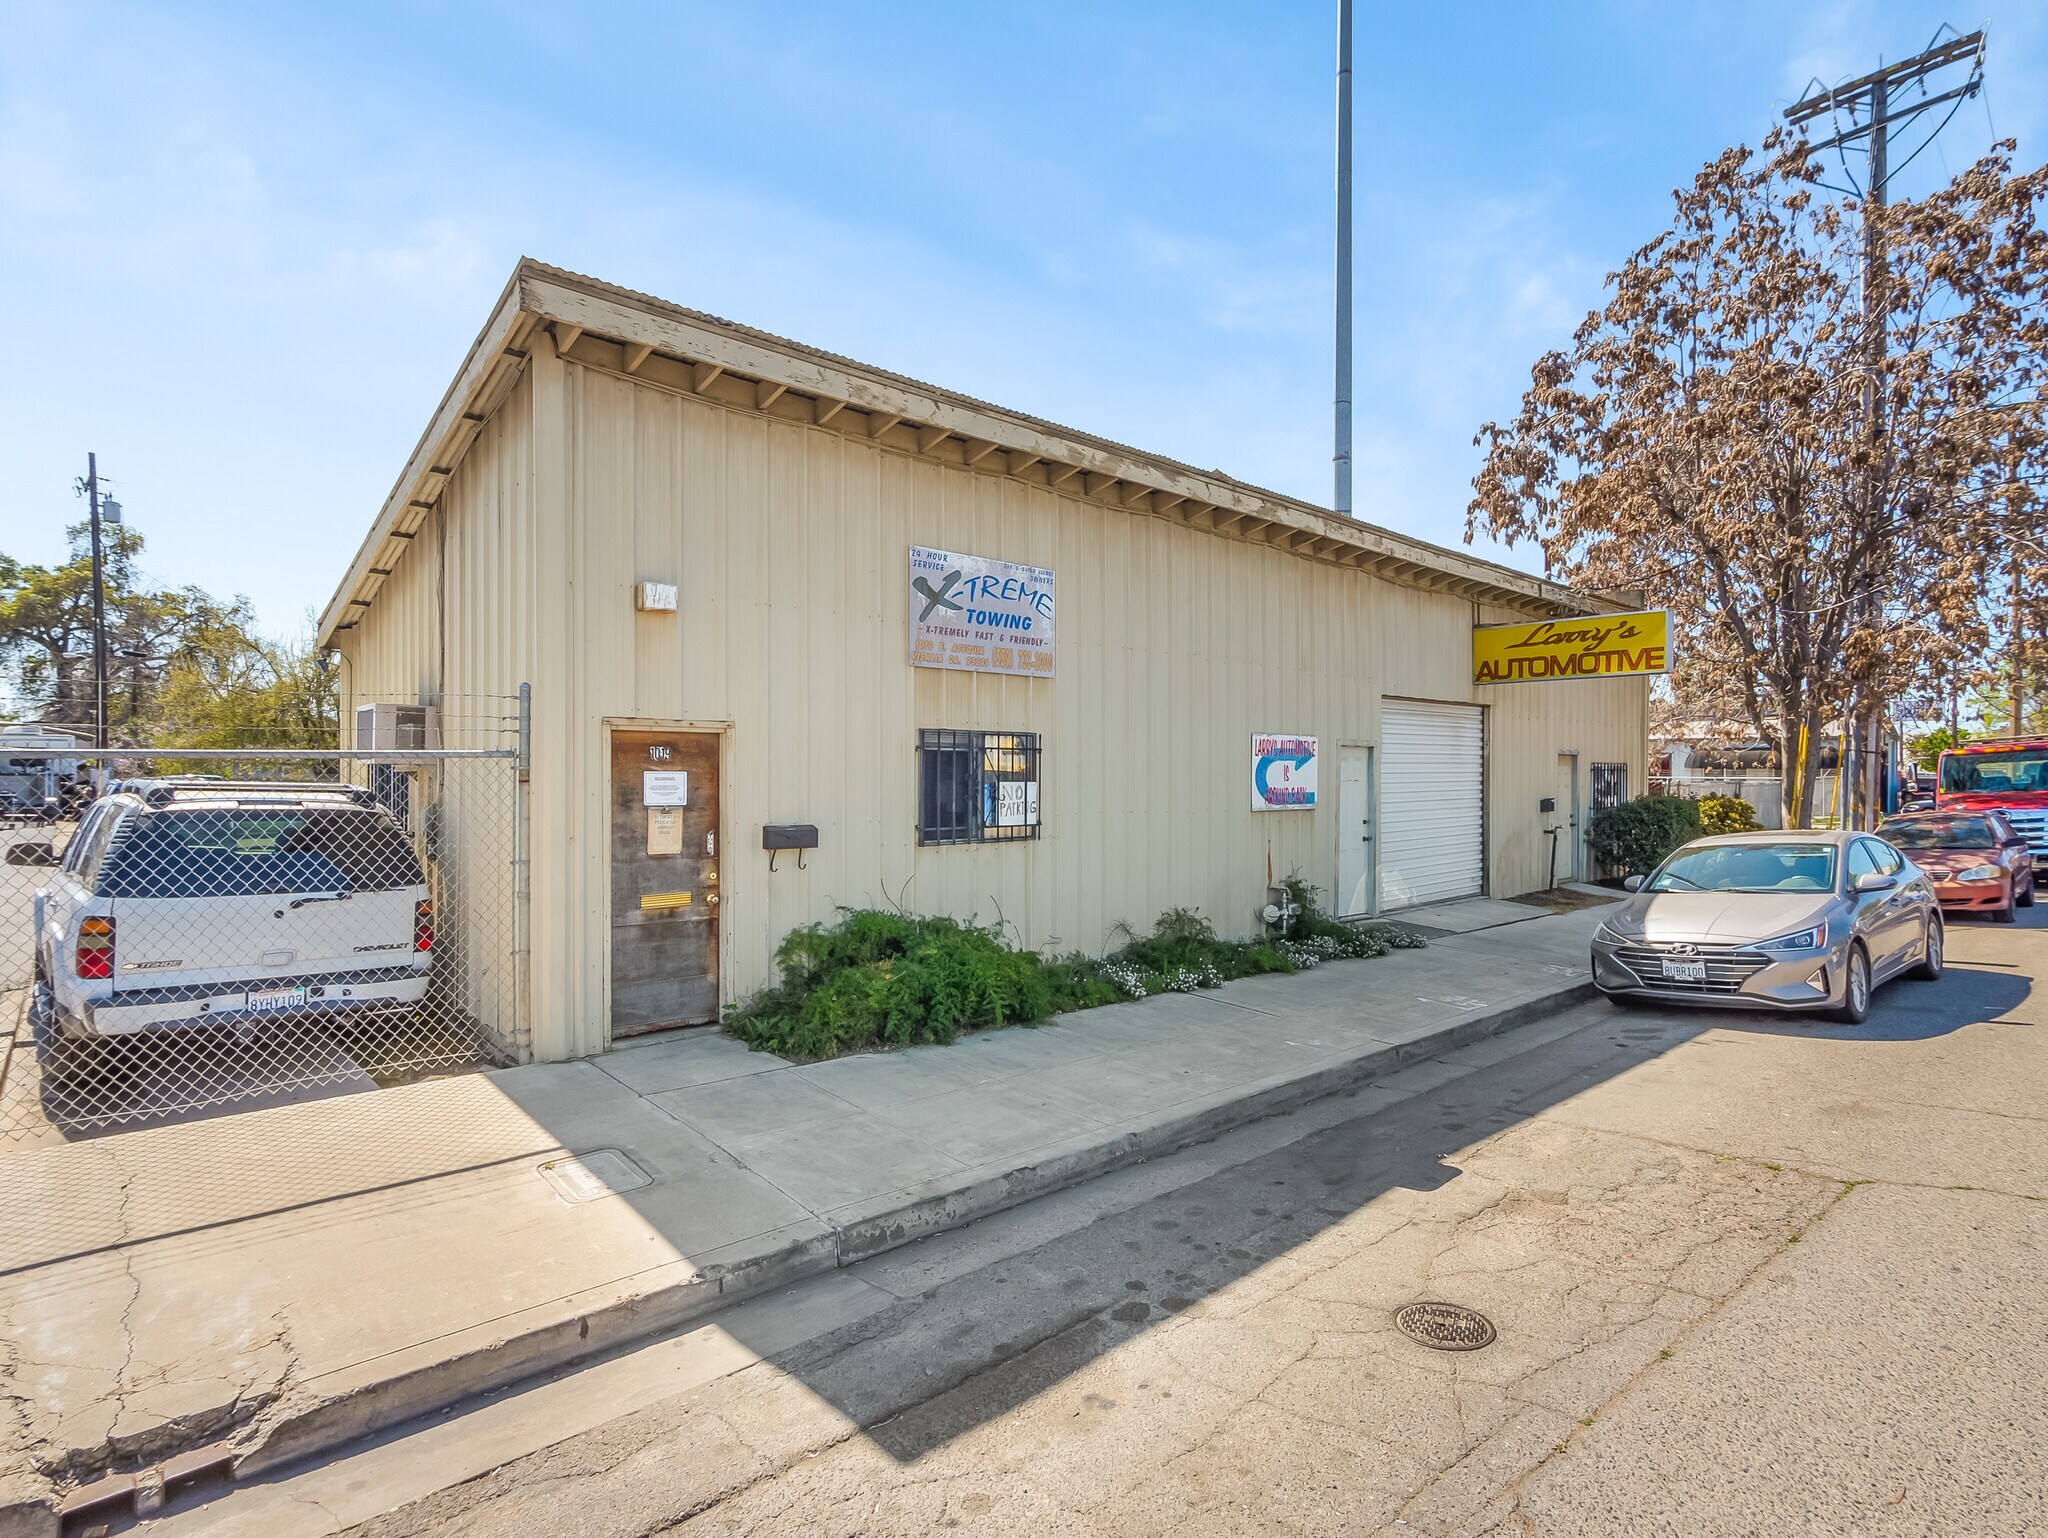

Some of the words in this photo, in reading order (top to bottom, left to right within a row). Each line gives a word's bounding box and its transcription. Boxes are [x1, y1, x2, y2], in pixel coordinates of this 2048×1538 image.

[911, 549, 921, 557] 24
[927, 551, 948, 562] HOUR
[912, 559, 945, 571] SERVICE
[1029, 575, 1054, 585] OWNERS
[966, 608, 1032, 631] TOWING
[925, 625, 969, 638] X-TREMELY
[975, 631, 994, 641] FAST
[1009, 635, 1043, 647] FRIENDLY
[1504, 620, 1643, 651] Larry's
[1474, 647, 1665, 682] AUTOMOTIVE
[1283, 763, 1290, 782] IS
[1002, 784, 1023, 801] NO
[250, 994, 303, 1011] 8YHY109
